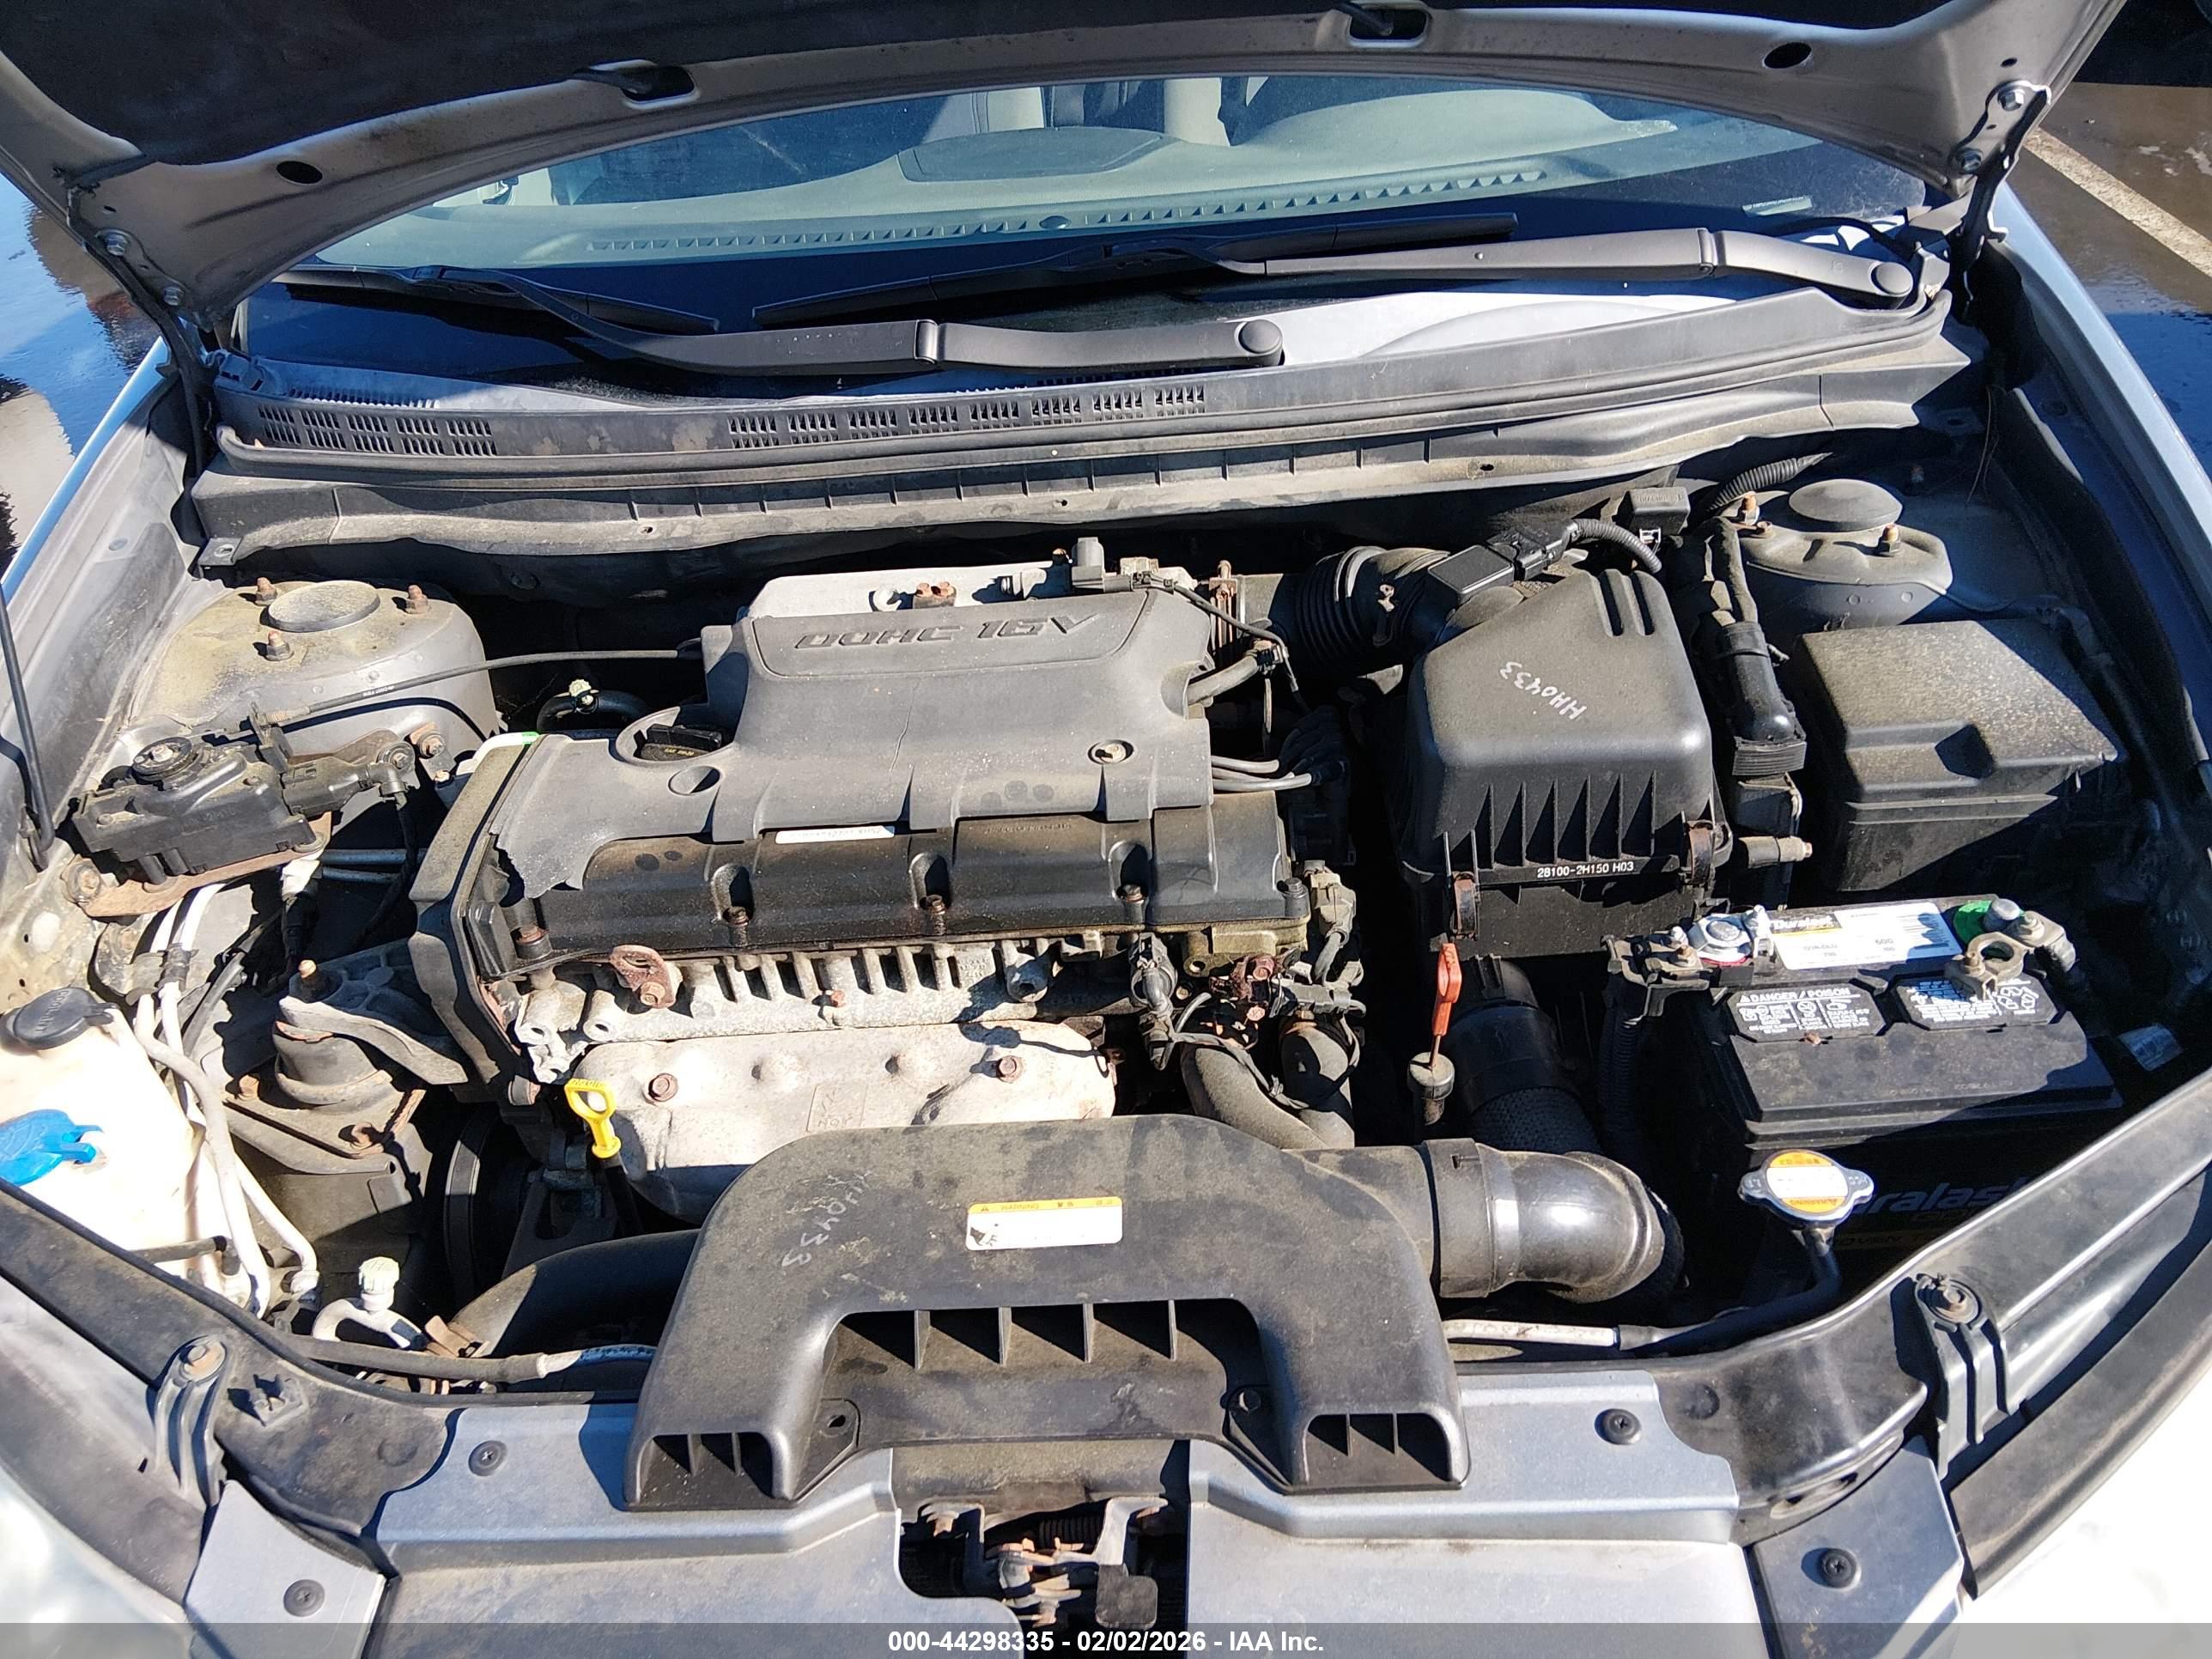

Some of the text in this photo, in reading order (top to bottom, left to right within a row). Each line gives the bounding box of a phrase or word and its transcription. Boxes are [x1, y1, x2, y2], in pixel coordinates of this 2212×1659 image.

[795, 612, 1100, 649] DOHC 16V
[1537, 861, 1634, 878] 28100-2H150 H03
[1750, 991, 1797, 1002] DANGER
[1808, 988, 1851, 998] POISON
[35, 990, 70, 1032] COOLANT
